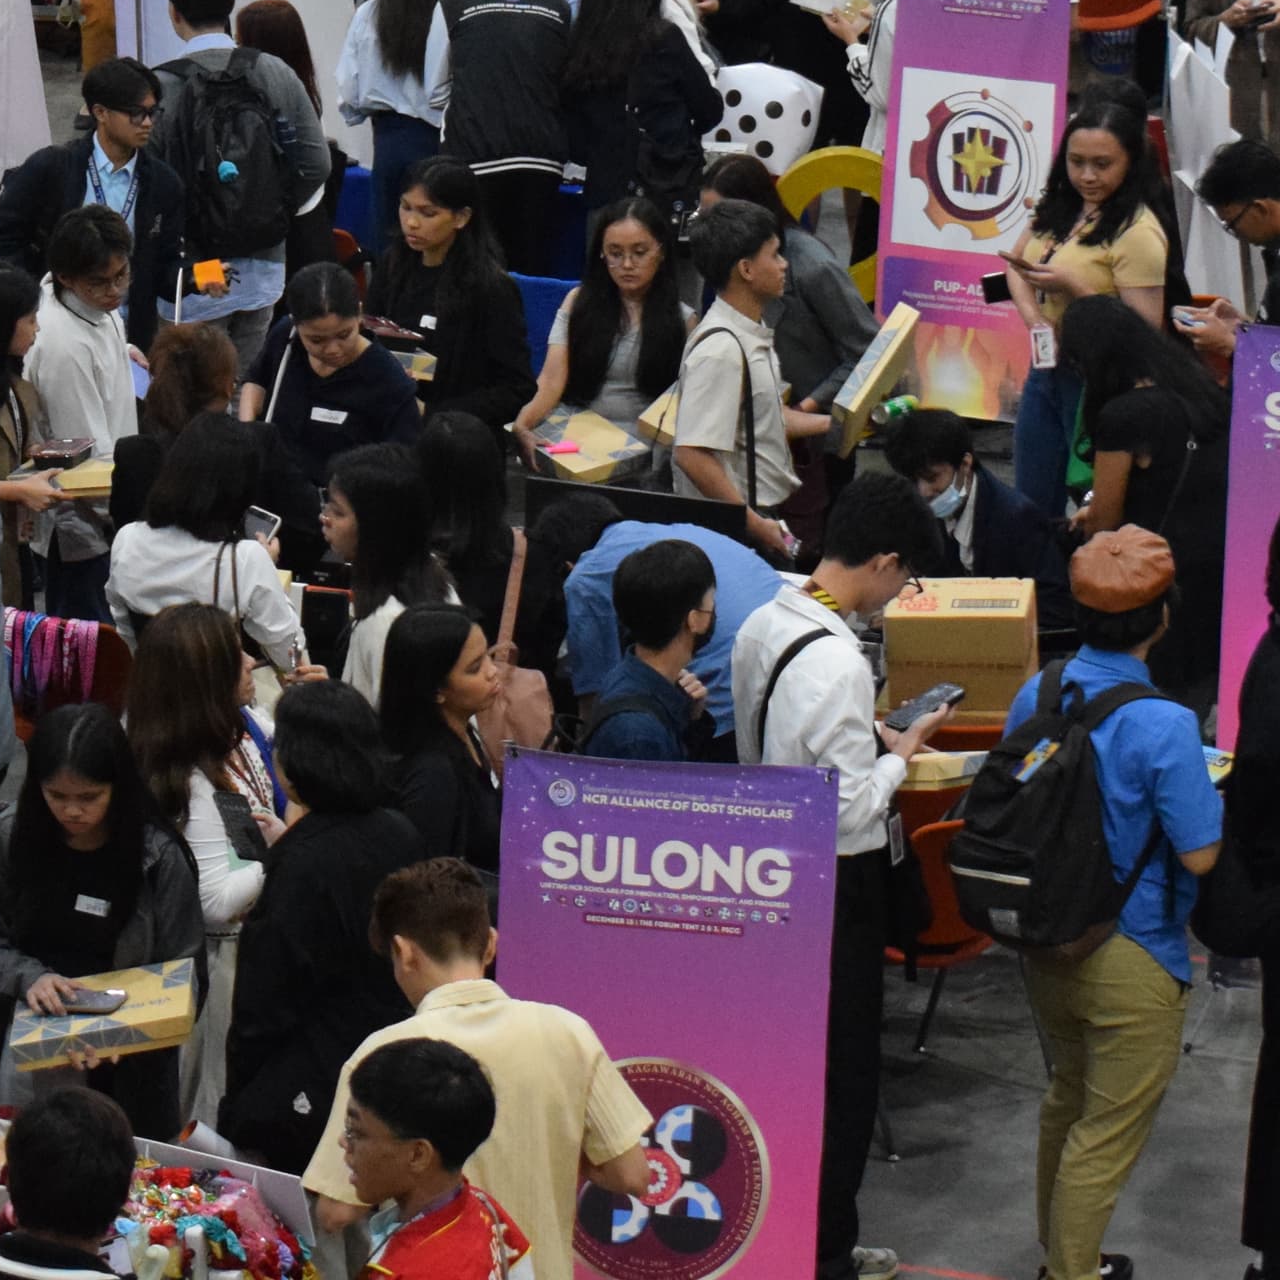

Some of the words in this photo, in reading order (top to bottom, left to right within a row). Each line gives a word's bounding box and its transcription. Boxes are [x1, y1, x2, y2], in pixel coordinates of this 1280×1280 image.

[934, 280, 984, 297] PUP-AD
[582, 794, 608, 805] NCR
[610, 796, 671, 810] ALLIANCE
[672, 800, 689, 811] OF
[692, 802, 725, 813] DOST
[727, 805, 793, 819] SCHOLARS
[541, 830, 792, 897] SULONG
[586, 915, 624, 924] DECEMBER
[640, 919, 653, 927] THE
[654, 920, 680, 929] FORUM
[626, 1064, 701, 1085] KAGAWARAN
[704, 1080, 720, 1097] NG
[721, 1098, 750, 1136] AGHAM
[734, 1159, 761, 1242] TEKNOLOHIYA
